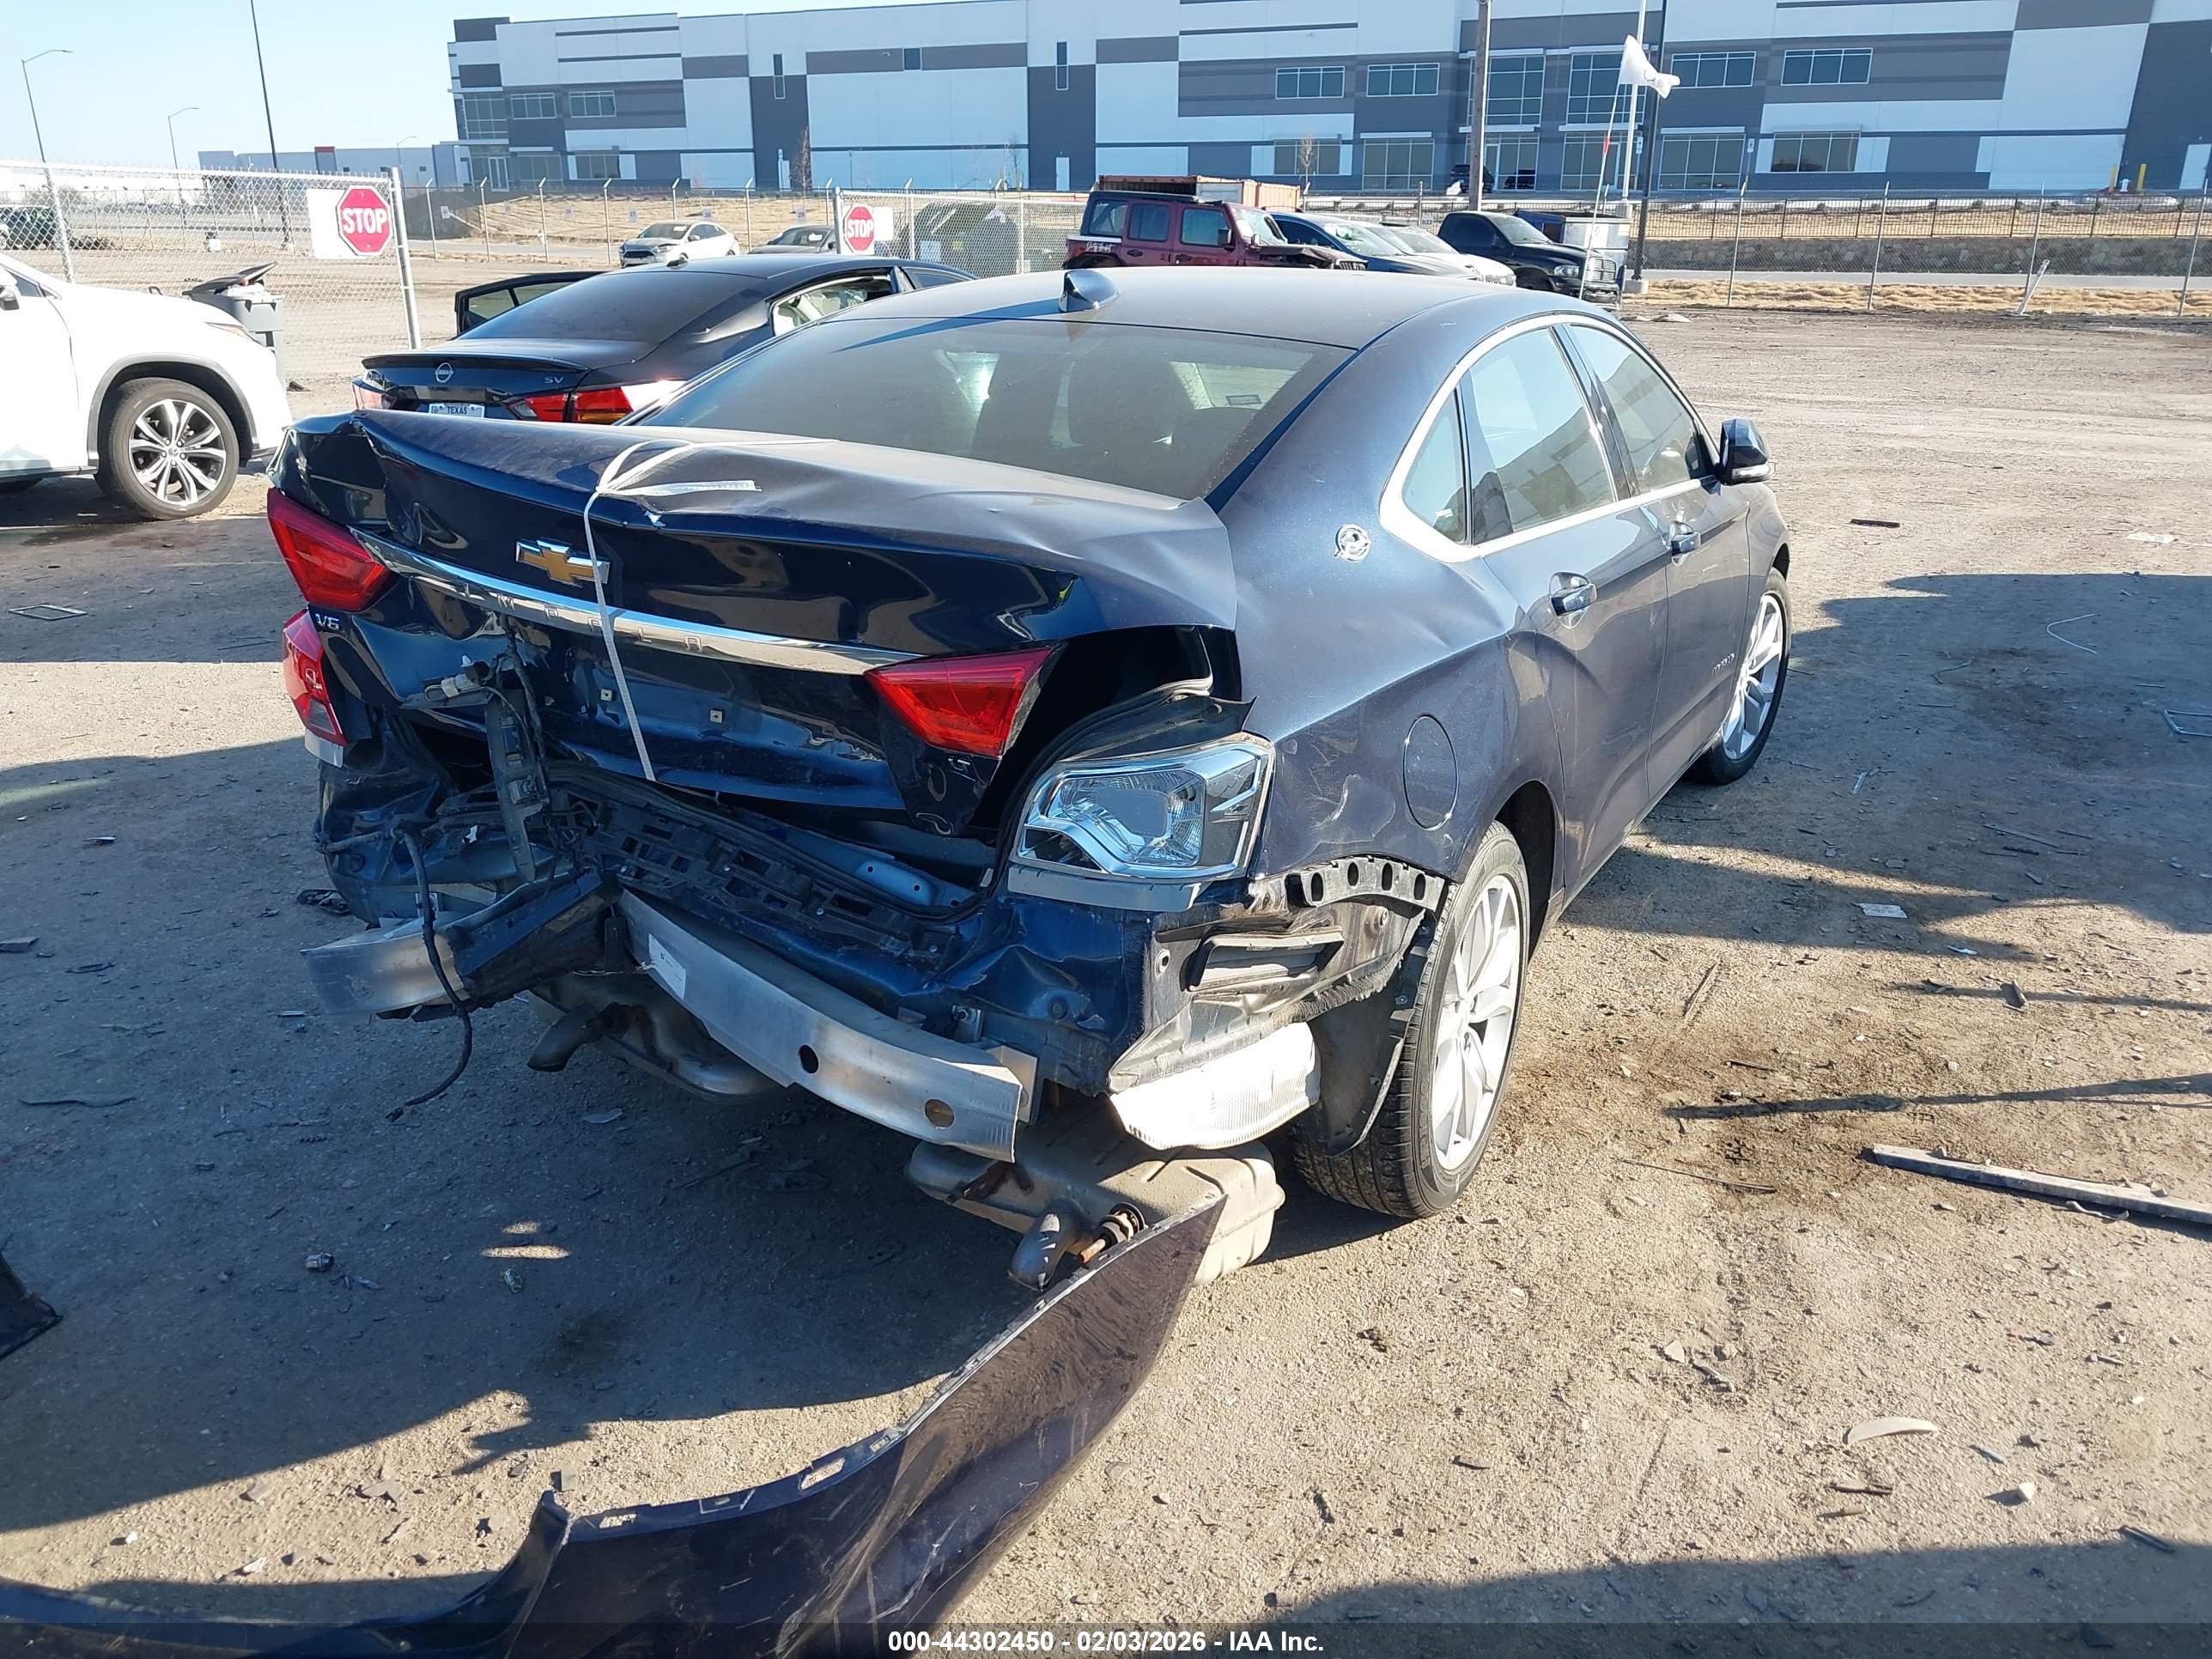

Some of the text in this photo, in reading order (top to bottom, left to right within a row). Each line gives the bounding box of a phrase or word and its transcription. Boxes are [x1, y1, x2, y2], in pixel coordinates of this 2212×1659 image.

[343, 207, 388, 234] STOP
[848, 219, 874, 239] STOP
[447, 405, 468, 416] TEXAS
[314, 612, 340, 631] V6
